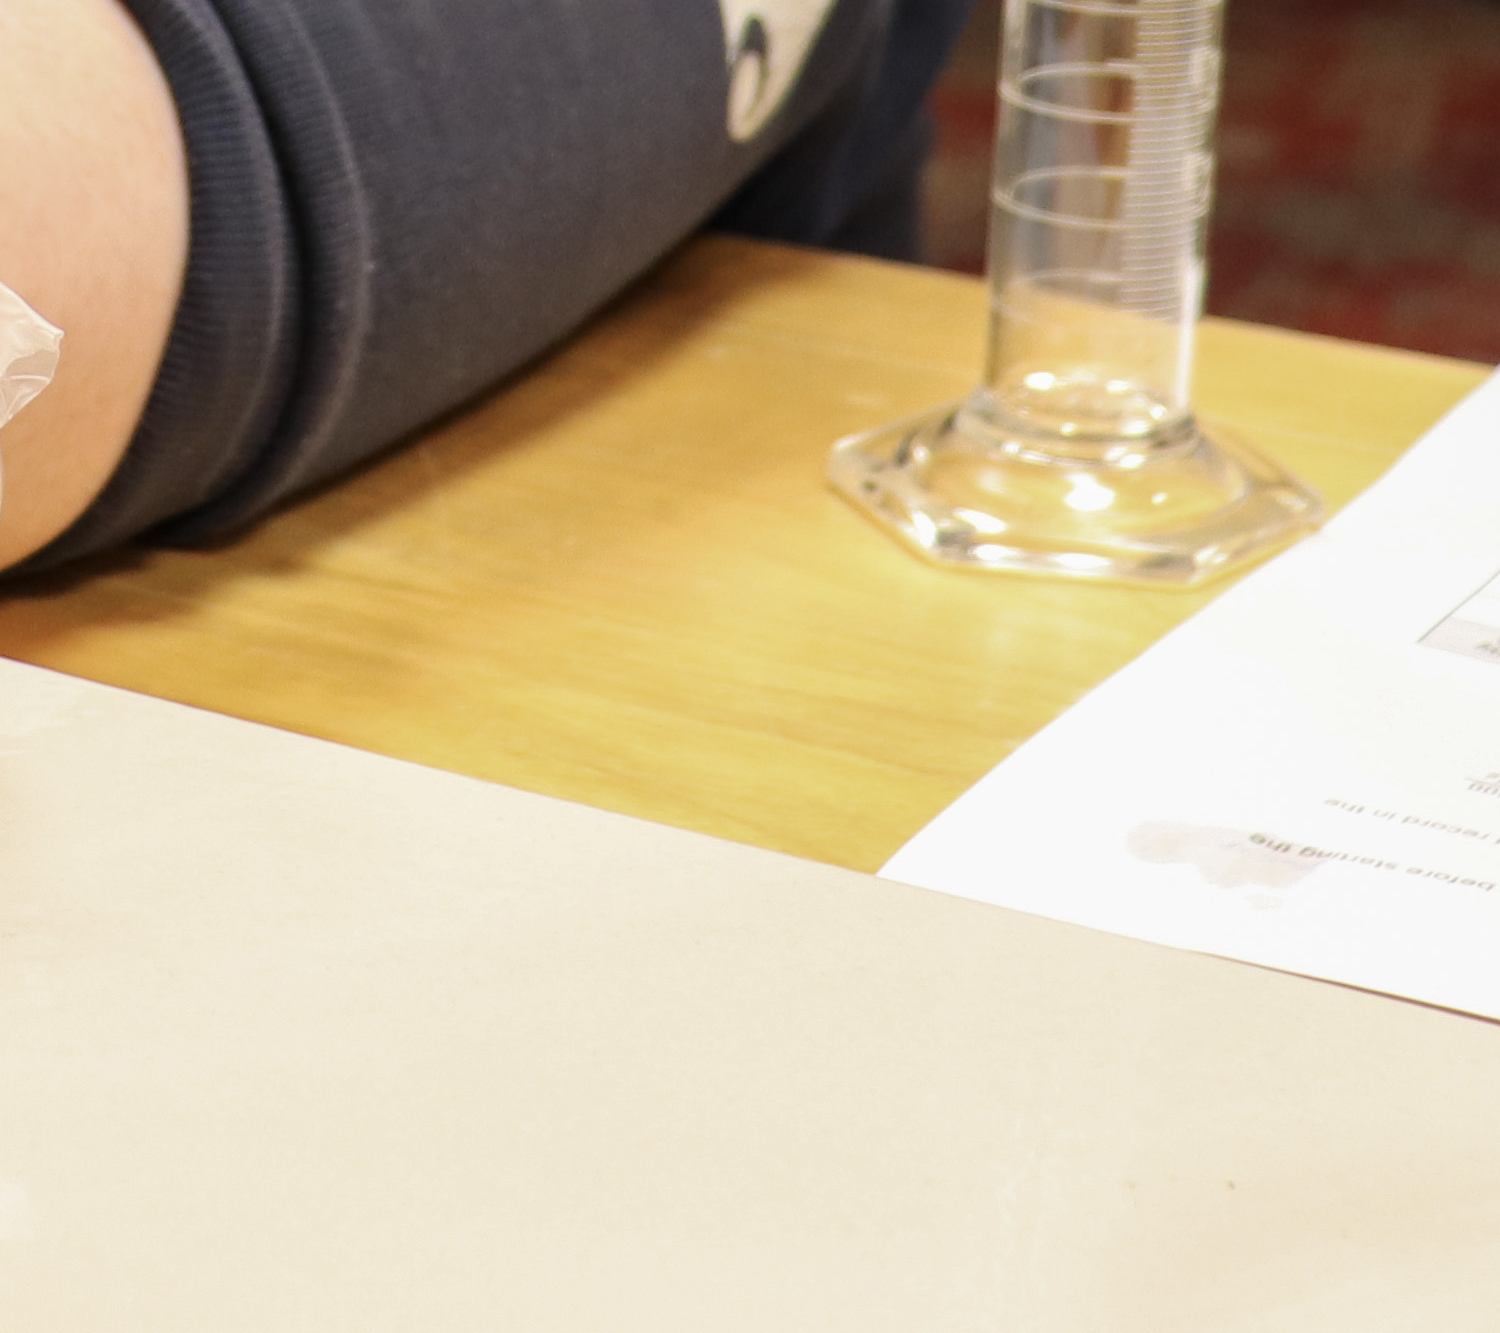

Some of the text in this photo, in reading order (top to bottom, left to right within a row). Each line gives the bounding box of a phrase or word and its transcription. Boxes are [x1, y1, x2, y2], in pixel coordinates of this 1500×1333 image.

[1322, 797, 1366, 815] the
[1372, 809, 1399, 821] in
[1400, 814, 1491, 841] record
[1404, 865, 1497, 893] before
